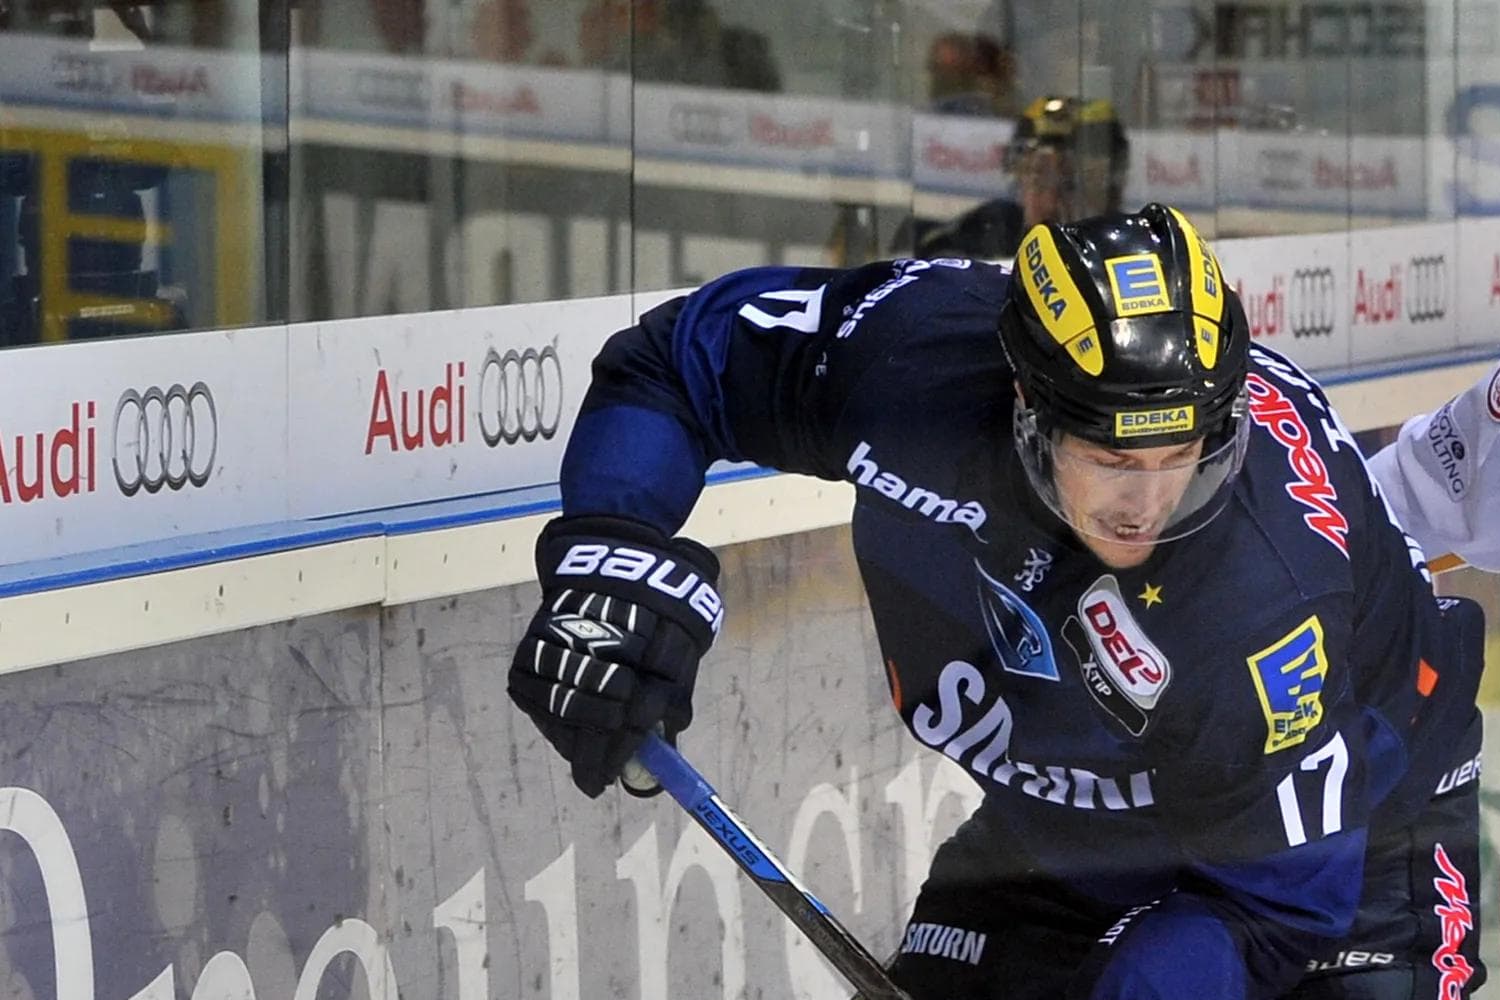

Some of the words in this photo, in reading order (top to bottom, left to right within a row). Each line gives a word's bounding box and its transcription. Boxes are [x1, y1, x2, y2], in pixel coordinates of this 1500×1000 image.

[1026, 237, 1068, 322] EDEKA
[1113, 260, 1160, 299] E
[1122, 298, 1166, 311] EDEKA
[1353, 264, 1402, 326] Audi
[365, 361, 465, 455] Audi
[1121, 408, 1188, 427] EDEKA
[846, 441, 989, 533] hama
[1085, 601, 1162, 685] DEL
[1276, 730, 1349, 847] 17
[902, 922, 987, 966] SATURN
